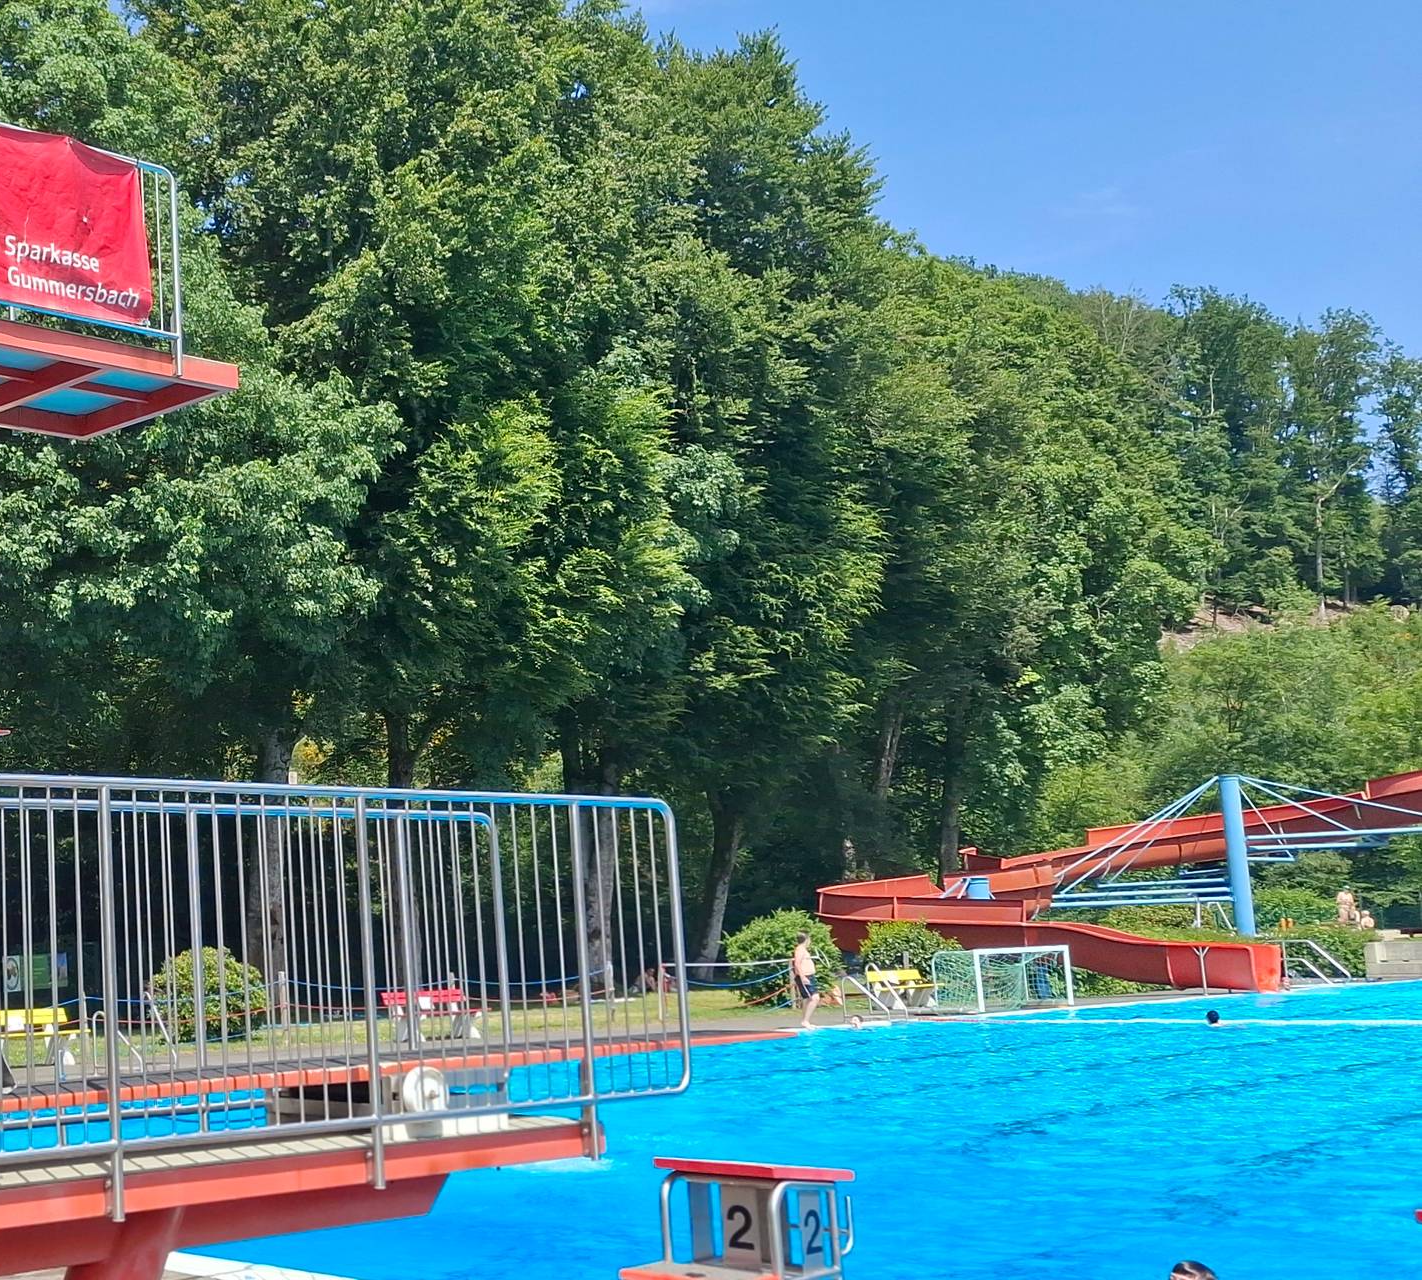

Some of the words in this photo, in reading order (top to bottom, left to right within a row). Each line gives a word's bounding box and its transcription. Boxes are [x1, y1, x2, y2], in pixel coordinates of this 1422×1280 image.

[4, 235, 100, 273] Sparkasse
[7, 266, 140, 308] Gummersbach
[726, 1204, 755, 1251] 2
[804, 1209, 823, 1256] 2
